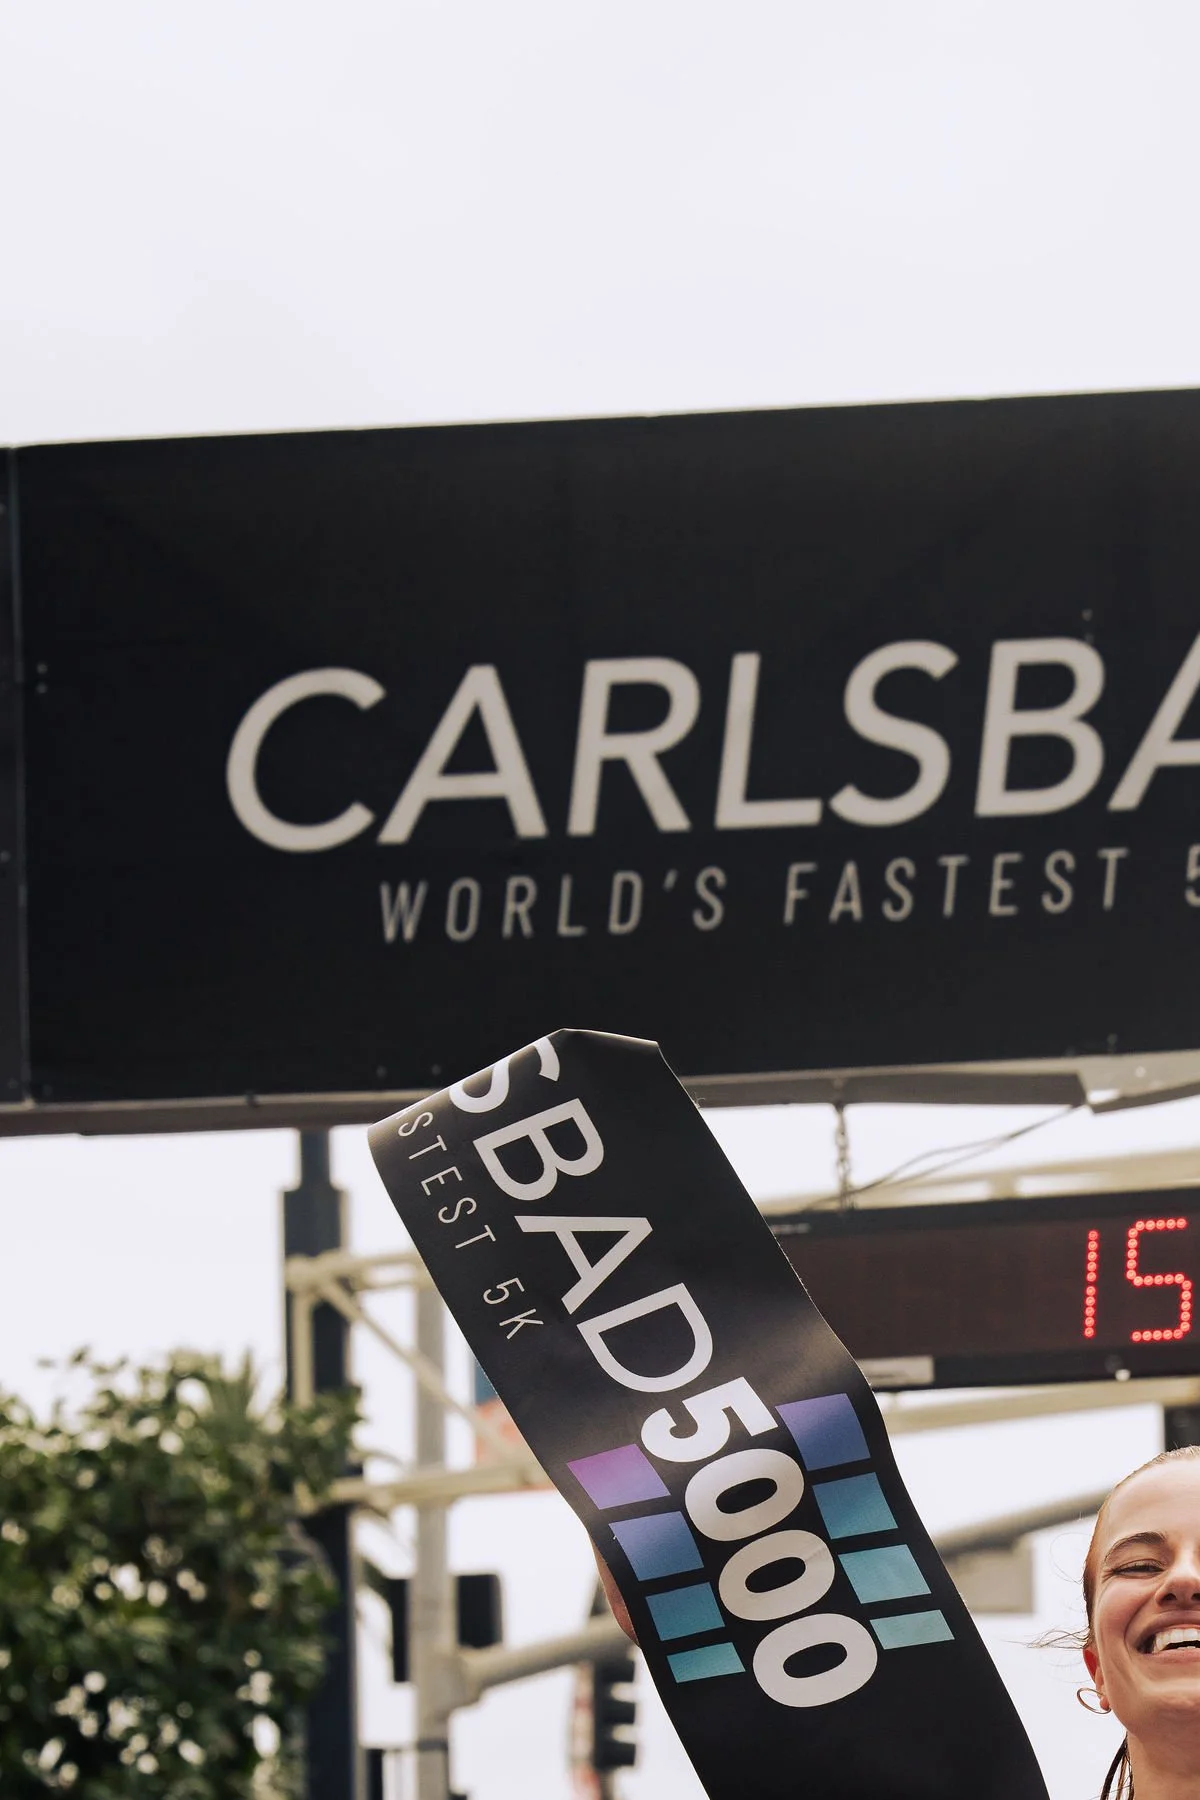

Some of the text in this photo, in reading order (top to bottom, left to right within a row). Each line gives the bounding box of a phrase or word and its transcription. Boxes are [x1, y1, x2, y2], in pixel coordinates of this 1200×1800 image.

[378, 864, 728, 944] WORLD'S
[783, 846, 1130, 924] FASTEST
[396, 1105, 544, 1340] STEST 5K
